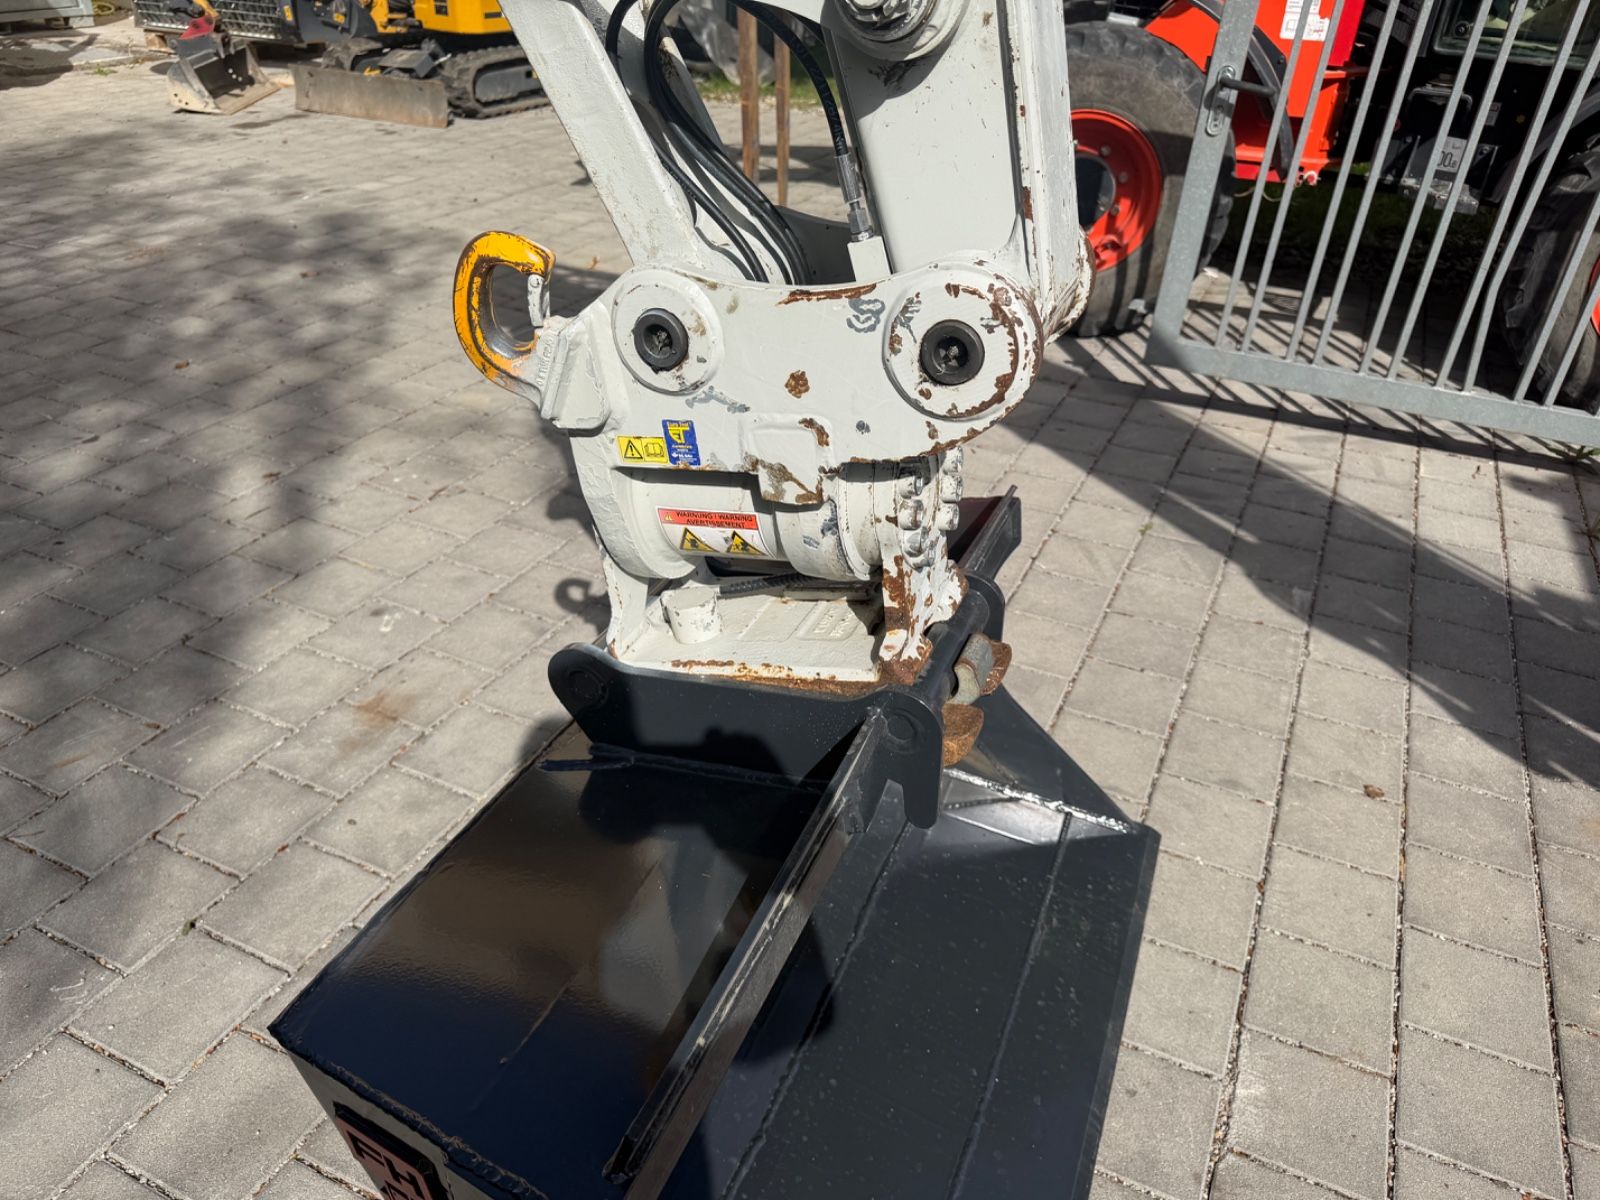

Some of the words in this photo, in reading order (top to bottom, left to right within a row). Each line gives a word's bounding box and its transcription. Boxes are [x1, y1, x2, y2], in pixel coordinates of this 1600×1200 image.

[676, 511, 713, 520] WARNUNG
[719, 514, 753, 522] WARNING
[686, 518, 746, 528] AVERTISSEMENT
